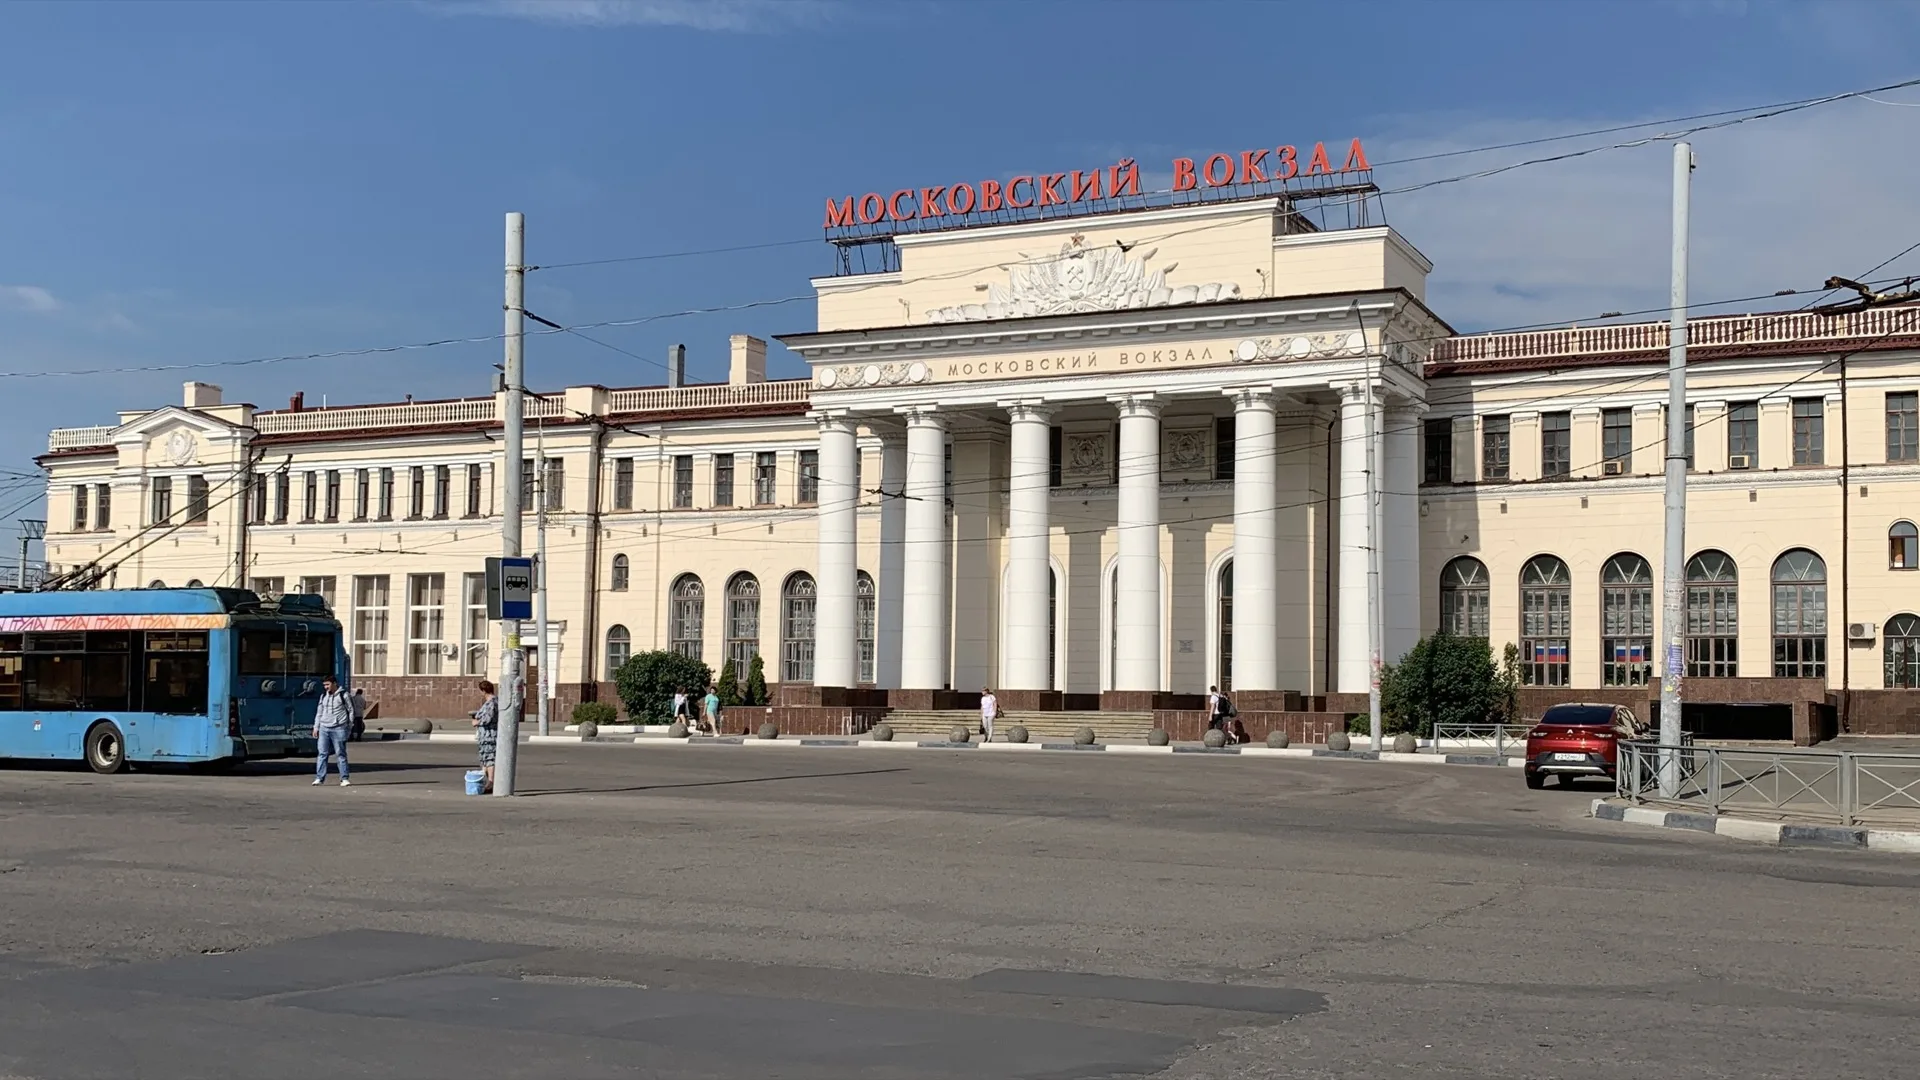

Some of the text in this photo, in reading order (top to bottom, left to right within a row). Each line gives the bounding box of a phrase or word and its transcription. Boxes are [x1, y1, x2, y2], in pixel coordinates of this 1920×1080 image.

[823, 137, 1372, 228] МОСКОВСКИЙ ВОКЗАЛ
[948, 347, 1212, 376] МОСКОВСКИЙ ВОКЗАЛ
